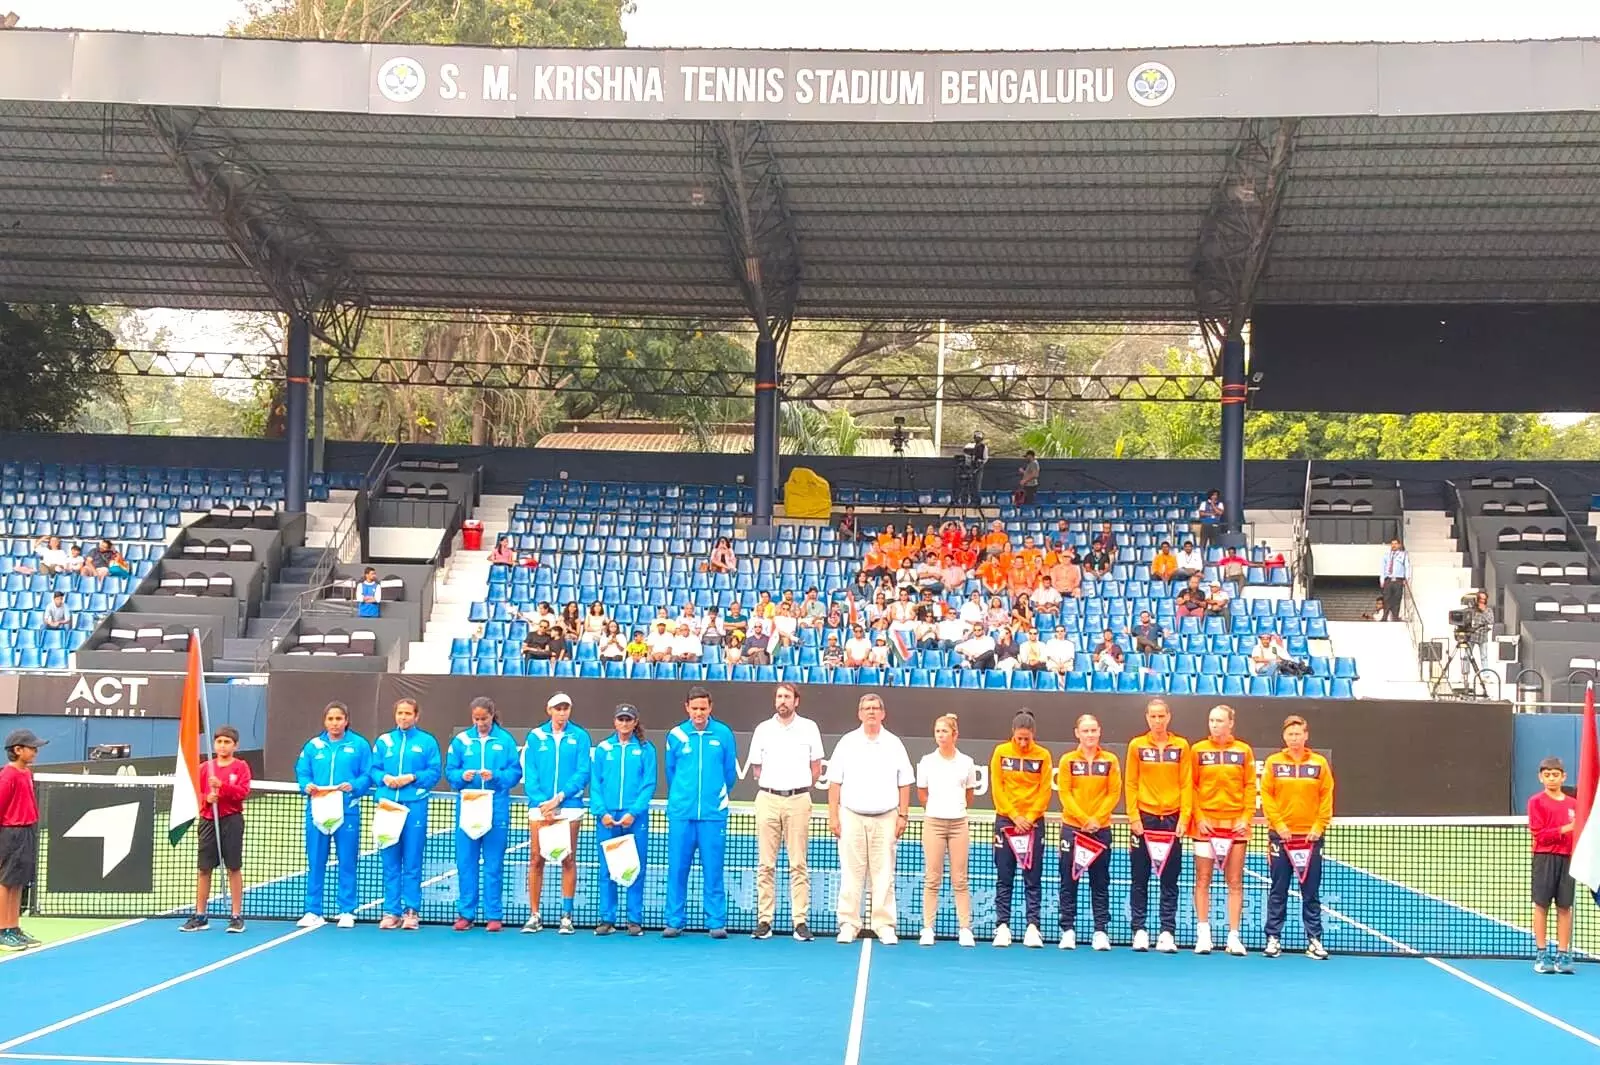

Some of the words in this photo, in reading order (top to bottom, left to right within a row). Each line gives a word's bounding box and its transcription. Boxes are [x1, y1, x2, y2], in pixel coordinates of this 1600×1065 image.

[440, 63, 466, 100] S.
[482, 65, 517, 101] M.
[533, 65, 664, 102] KRISHNA
[681, 67, 783, 103] TENNIS
[795, 68, 925, 105] STADIUM
[941, 68, 1114, 104] BENGALURU
[66, 674, 149, 706] ACT
